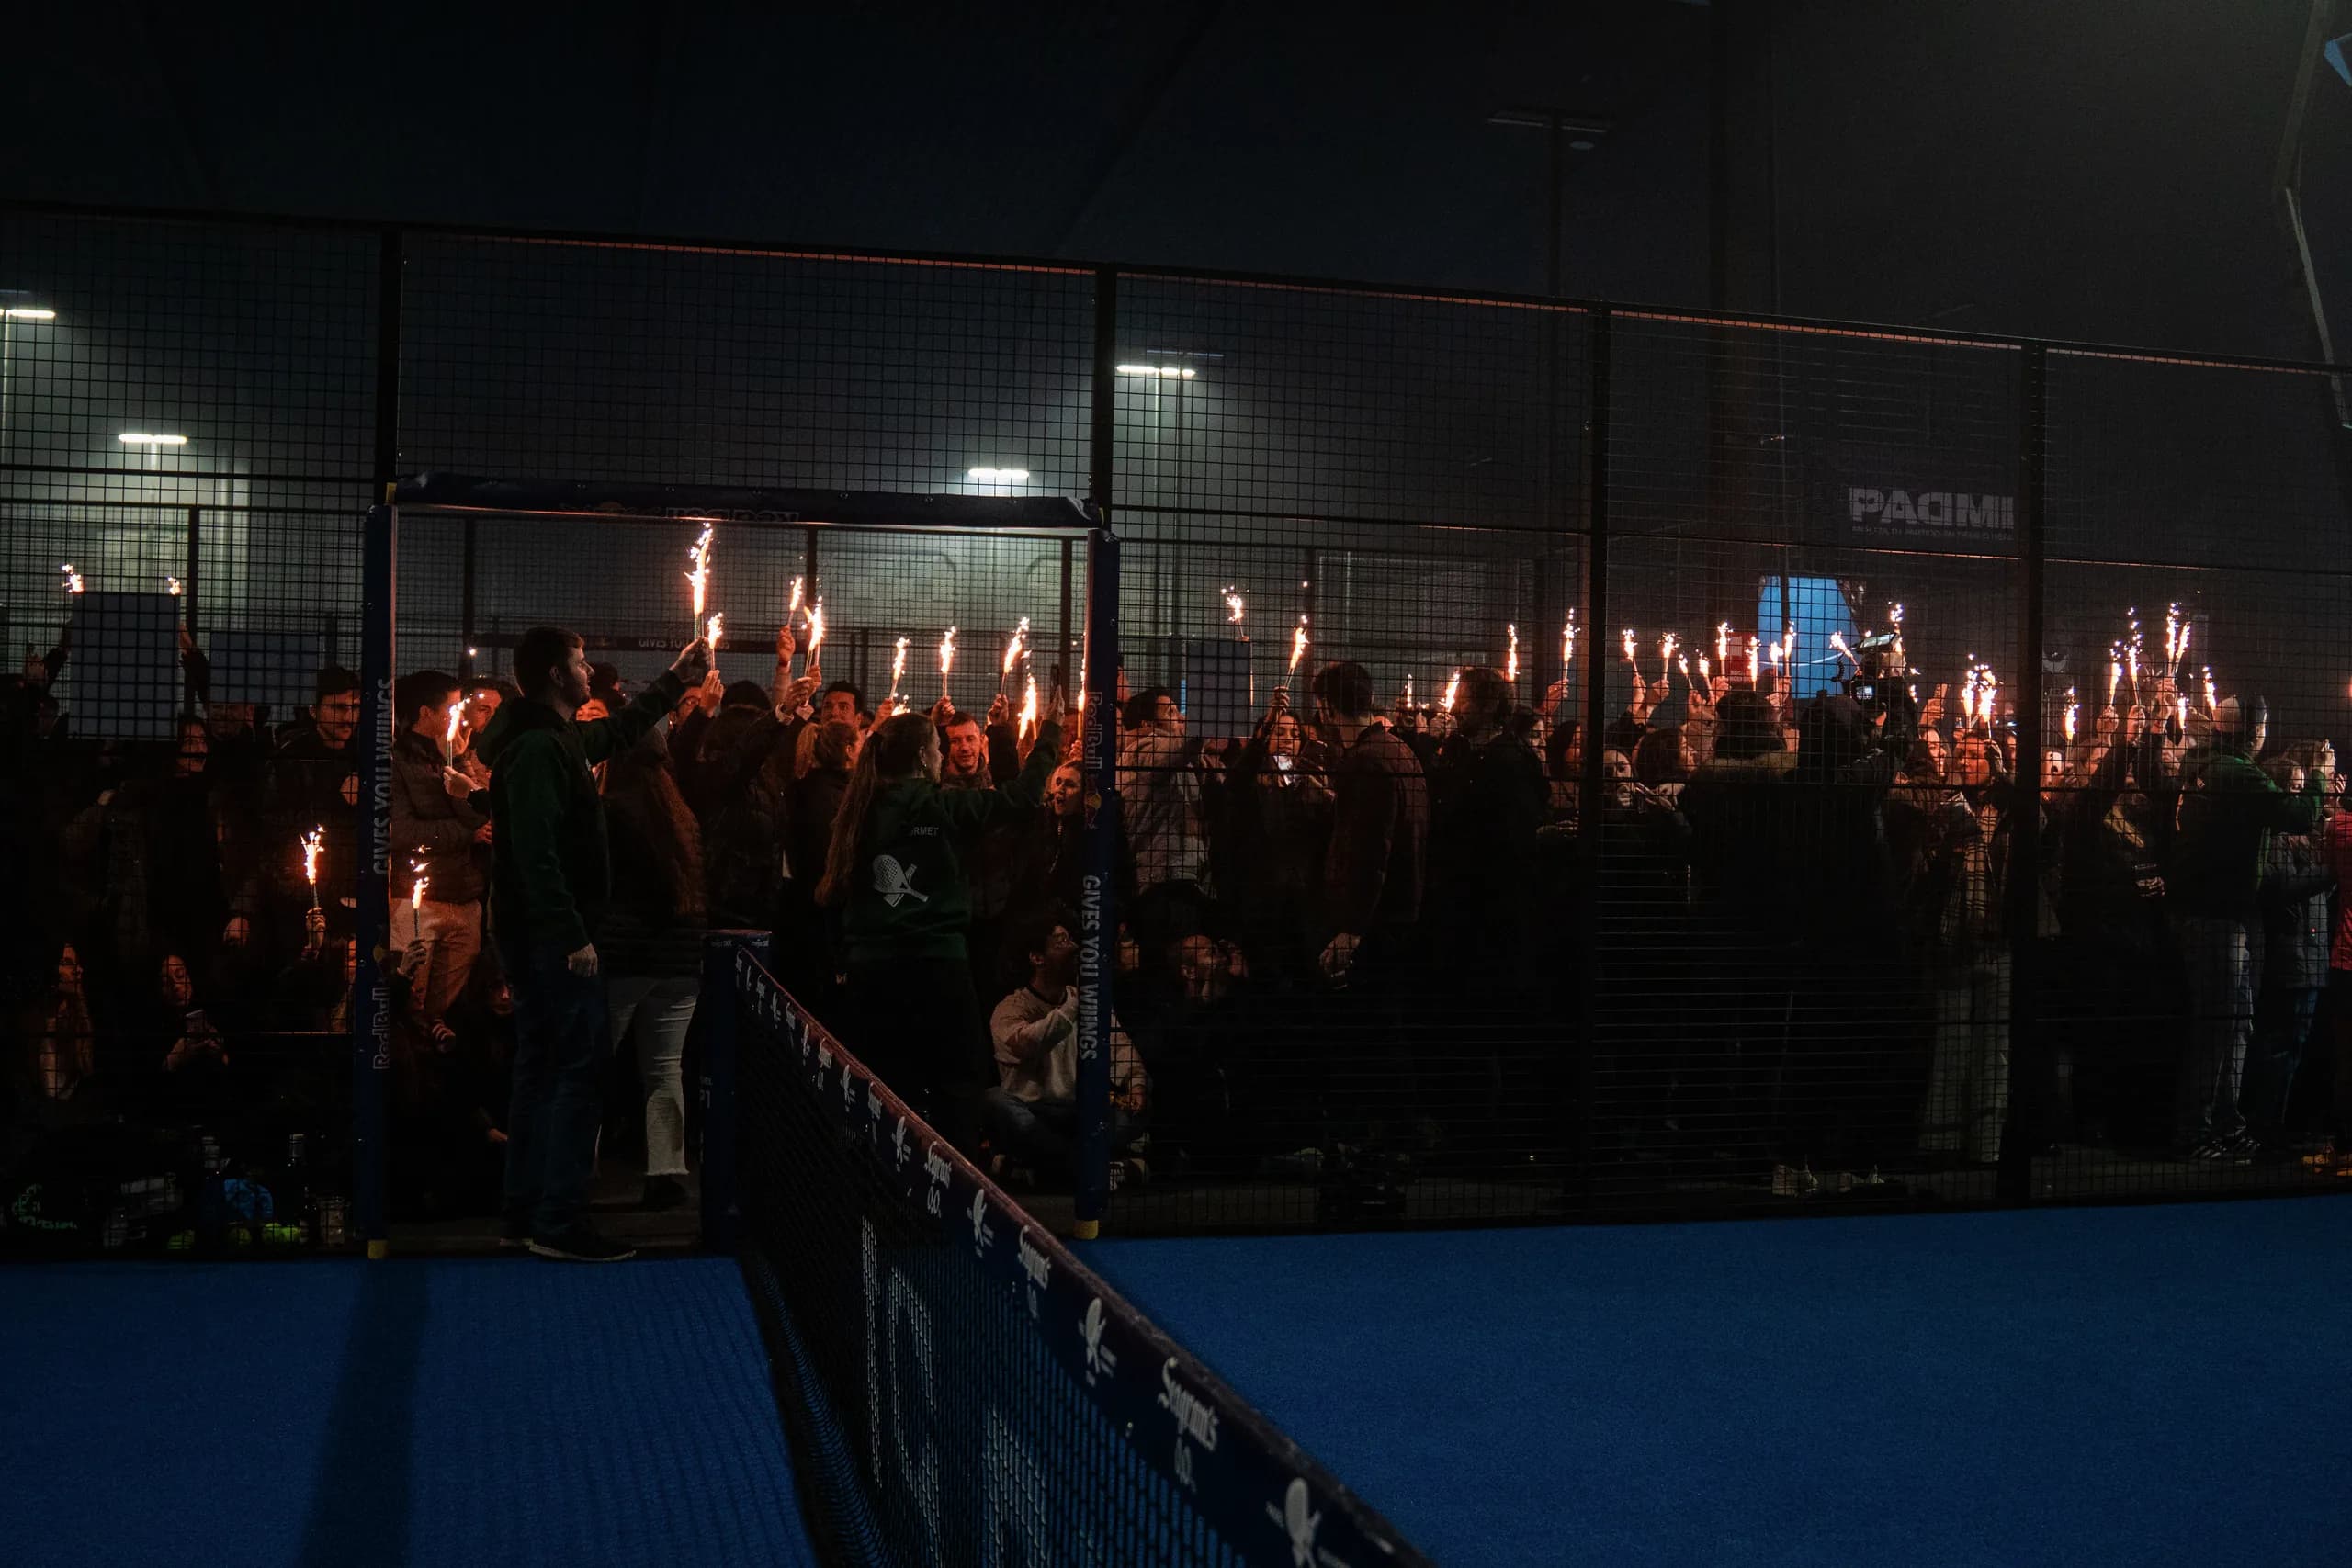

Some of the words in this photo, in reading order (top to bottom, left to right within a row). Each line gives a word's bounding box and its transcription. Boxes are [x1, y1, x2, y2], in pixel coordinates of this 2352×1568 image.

[374, 767, 391, 811] YOU
[372, 817, 391, 874] GIVES
[1082, 874, 1102, 931] GIVES
[1080, 939, 1100, 977] YOU
